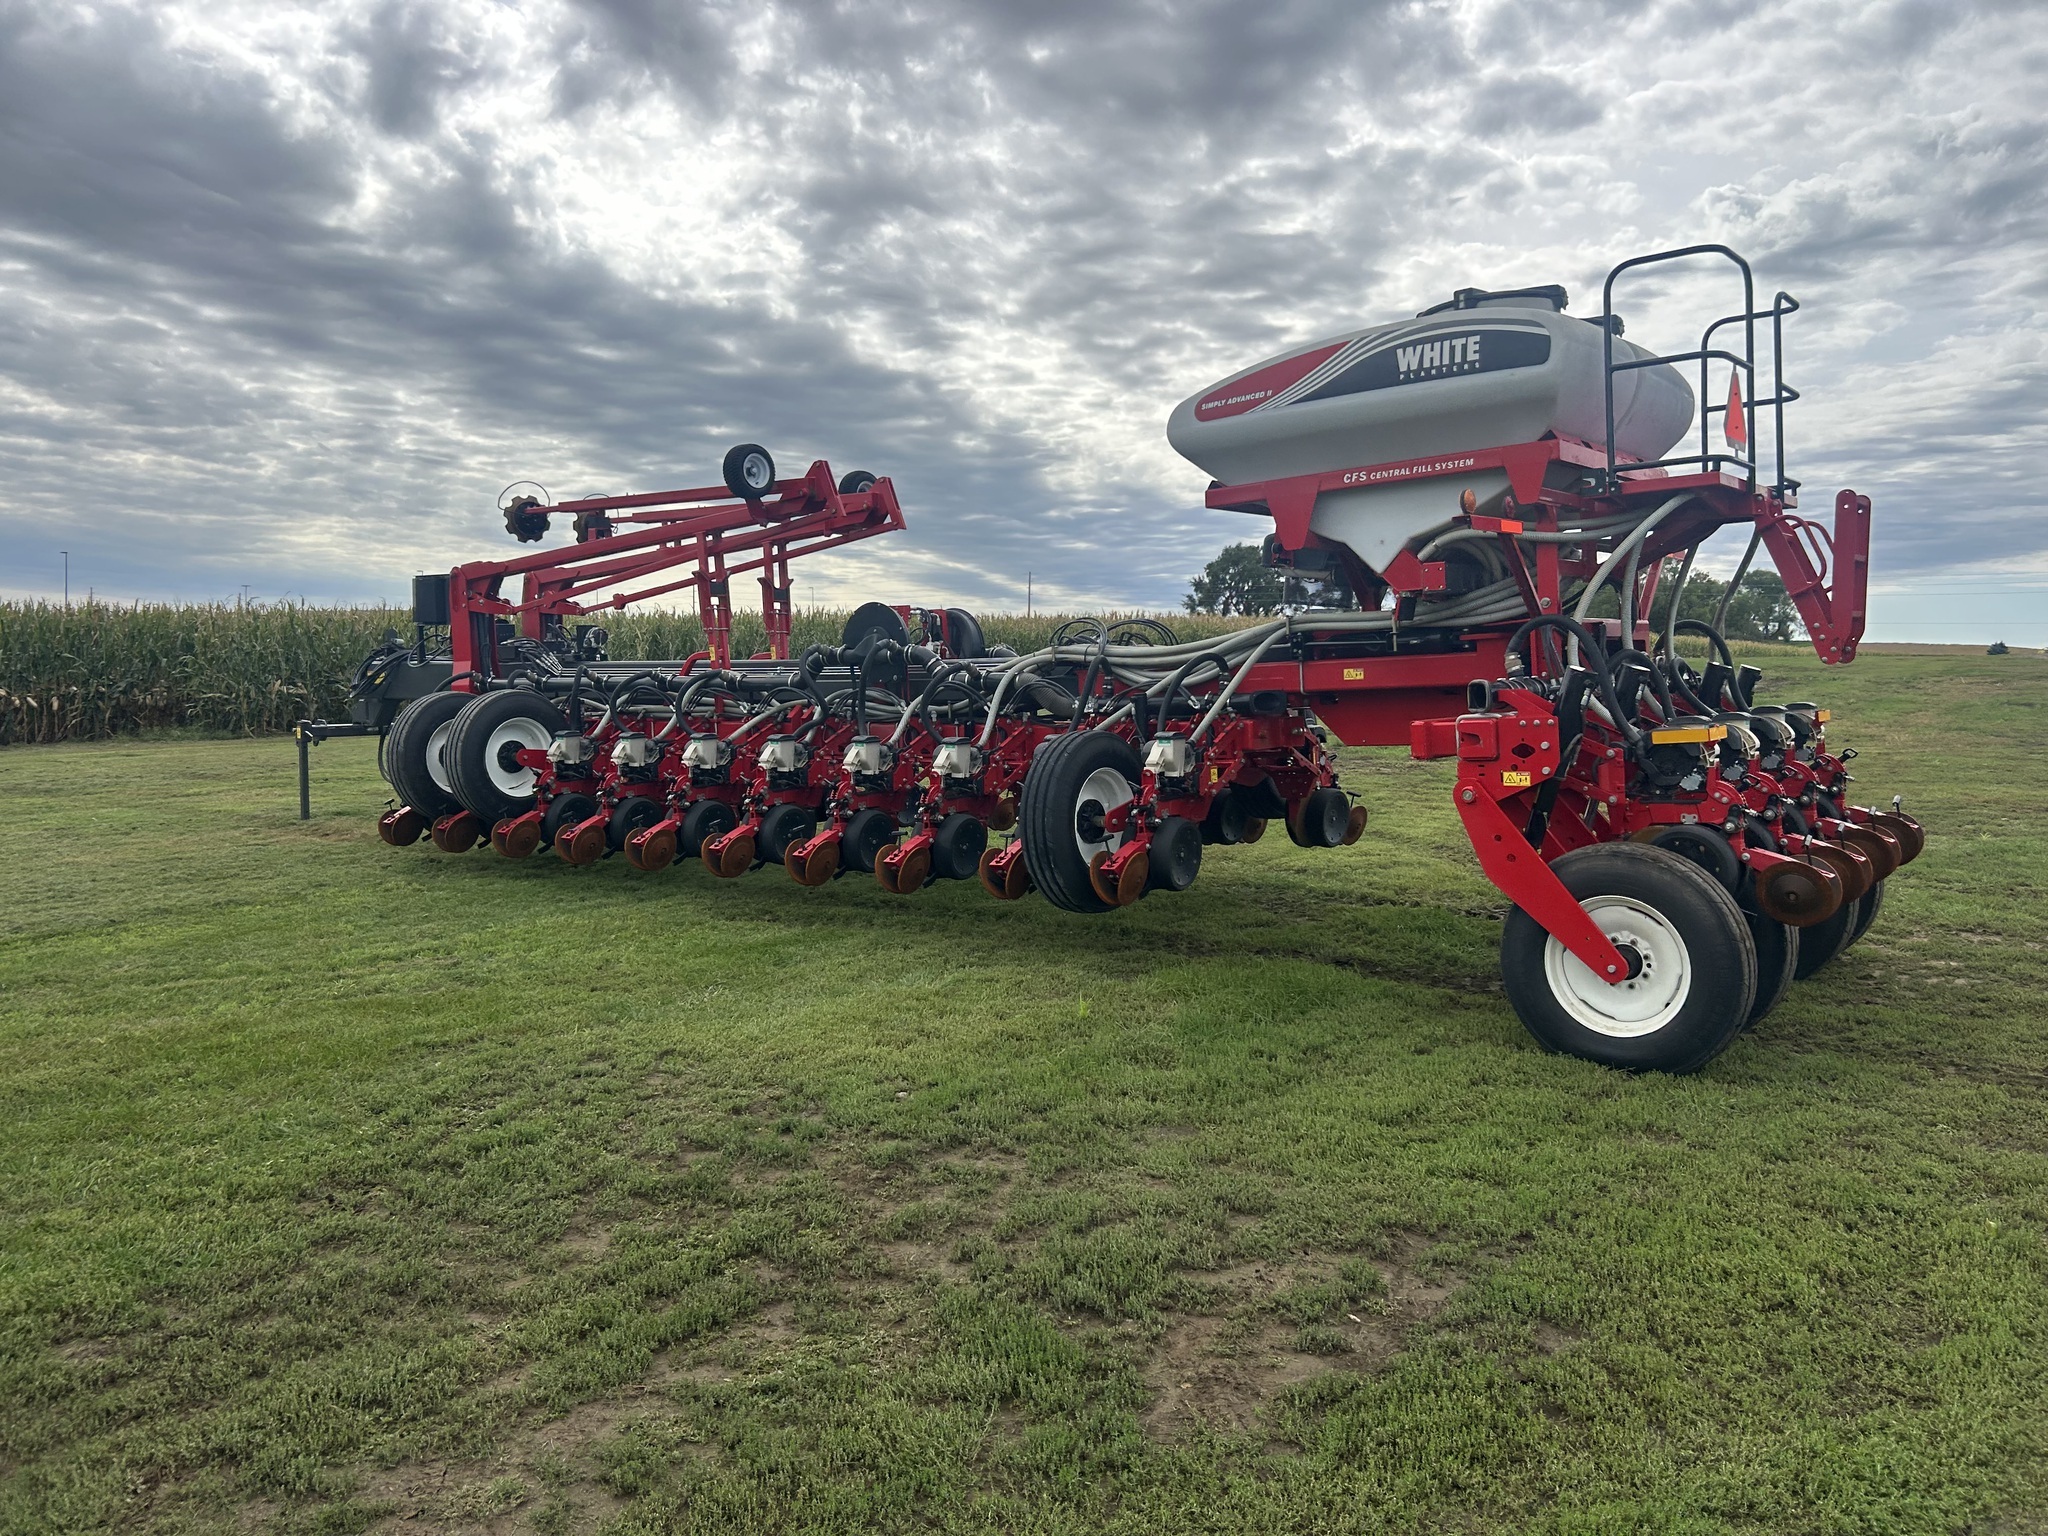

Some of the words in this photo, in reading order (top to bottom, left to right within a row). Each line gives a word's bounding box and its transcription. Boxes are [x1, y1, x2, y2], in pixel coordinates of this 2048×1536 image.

[1396, 335, 1480, 372] WHITE
[1399, 362, 1480, 380] PLANTERS
[1201, 399, 1226, 410] SIMPLY
[1226, 391, 1265, 405] ADVANCED
[1343, 471, 1367, 484] CFS
[1370, 467, 1410, 480] CENTRAL
[1412, 464, 1432, 474] FILL
[1435, 458, 1474, 471] SYSTEM
